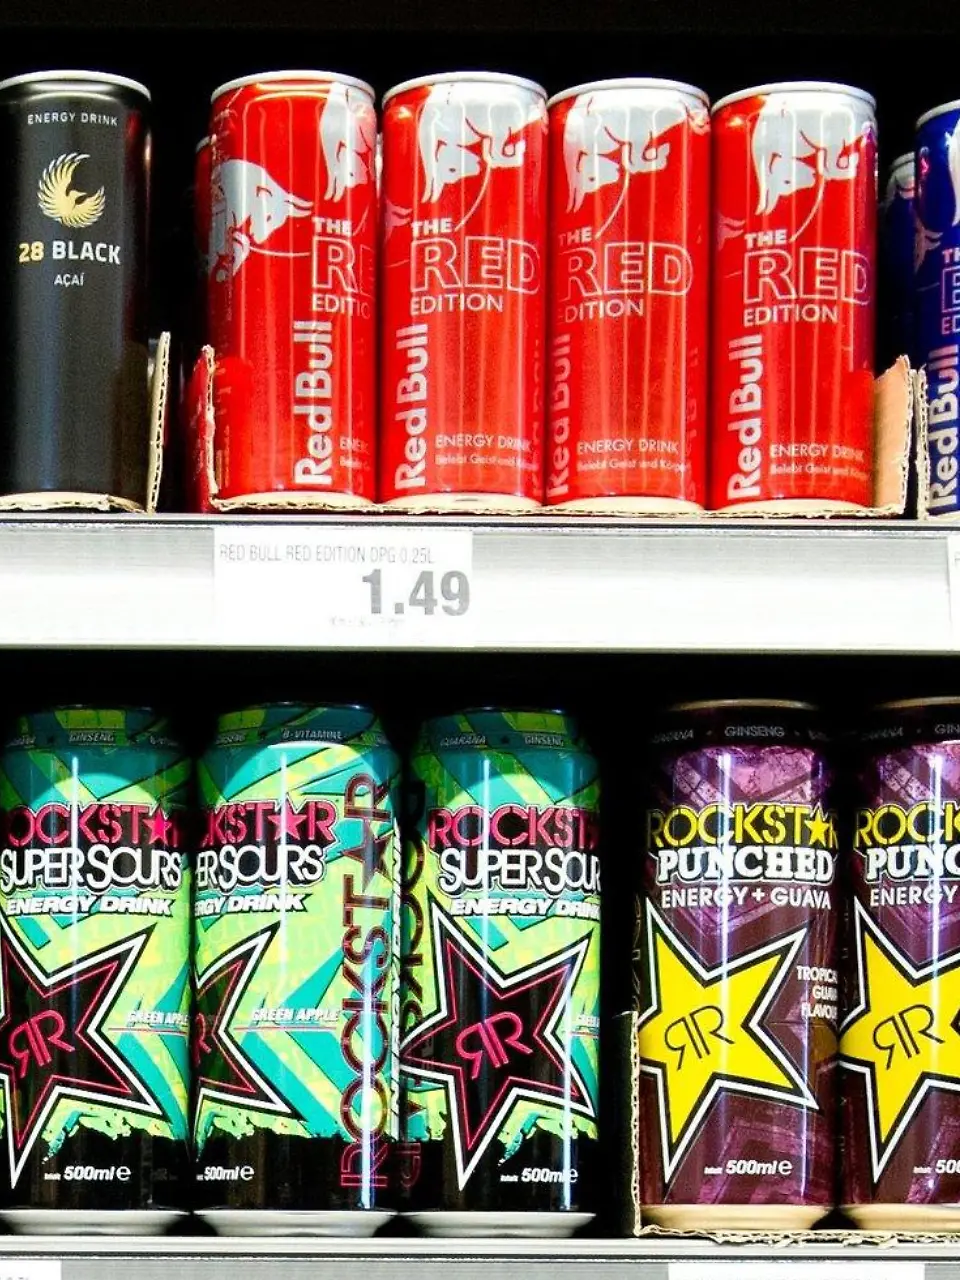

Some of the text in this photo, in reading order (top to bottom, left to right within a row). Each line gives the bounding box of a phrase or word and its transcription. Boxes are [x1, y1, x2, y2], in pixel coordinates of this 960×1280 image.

[27, 111, 118, 127] ENERGY DRINK
[312, 216, 352, 237] THE
[411, 218, 452, 238] THE
[744, 228, 787, 249] THE
[18, 240, 121, 265] 28 BLACK
[410, 236, 540, 295] RED
[560, 241, 694, 301] RED
[743, 246, 870, 306] RED
[54, 272, 84, 287] AÇAÍ
[410, 292, 503, 316] EDITION
[743, 304, 839, 327] EDITION
[293, 320, 333, 485] Red Bull
[395, 324, 428, 490] Red Bull
[728, 334, 763, 500] Red Bull
[435, 433, 492, 449] ENERGY
[577, 439, 679, 455] ENERGY DRINK
[770, 443, 828, 458] ENERGY
[220, 544, 245, 561] RED
[250, 544, 281, 562] BULL
[286, 544, 312, 562] RED
[316, 545, 365, 562] EDITION
[362, 568, 470, 616] 1.49
[724, 725, 785, 738] GINSENG
[657, 847, 835, 883] PUNCHED
[6, 896, 174, 917] ENERGY DRINK
[226, 892, 307, 913] DRINK
[451, 897, 548, 917] ENERGY
[661, 887, 831, 911] ENERGY GUAVA
[869, 887, 958, 909] ENERGY
[251, 1007, 339, 1022] GREEN APPLE
